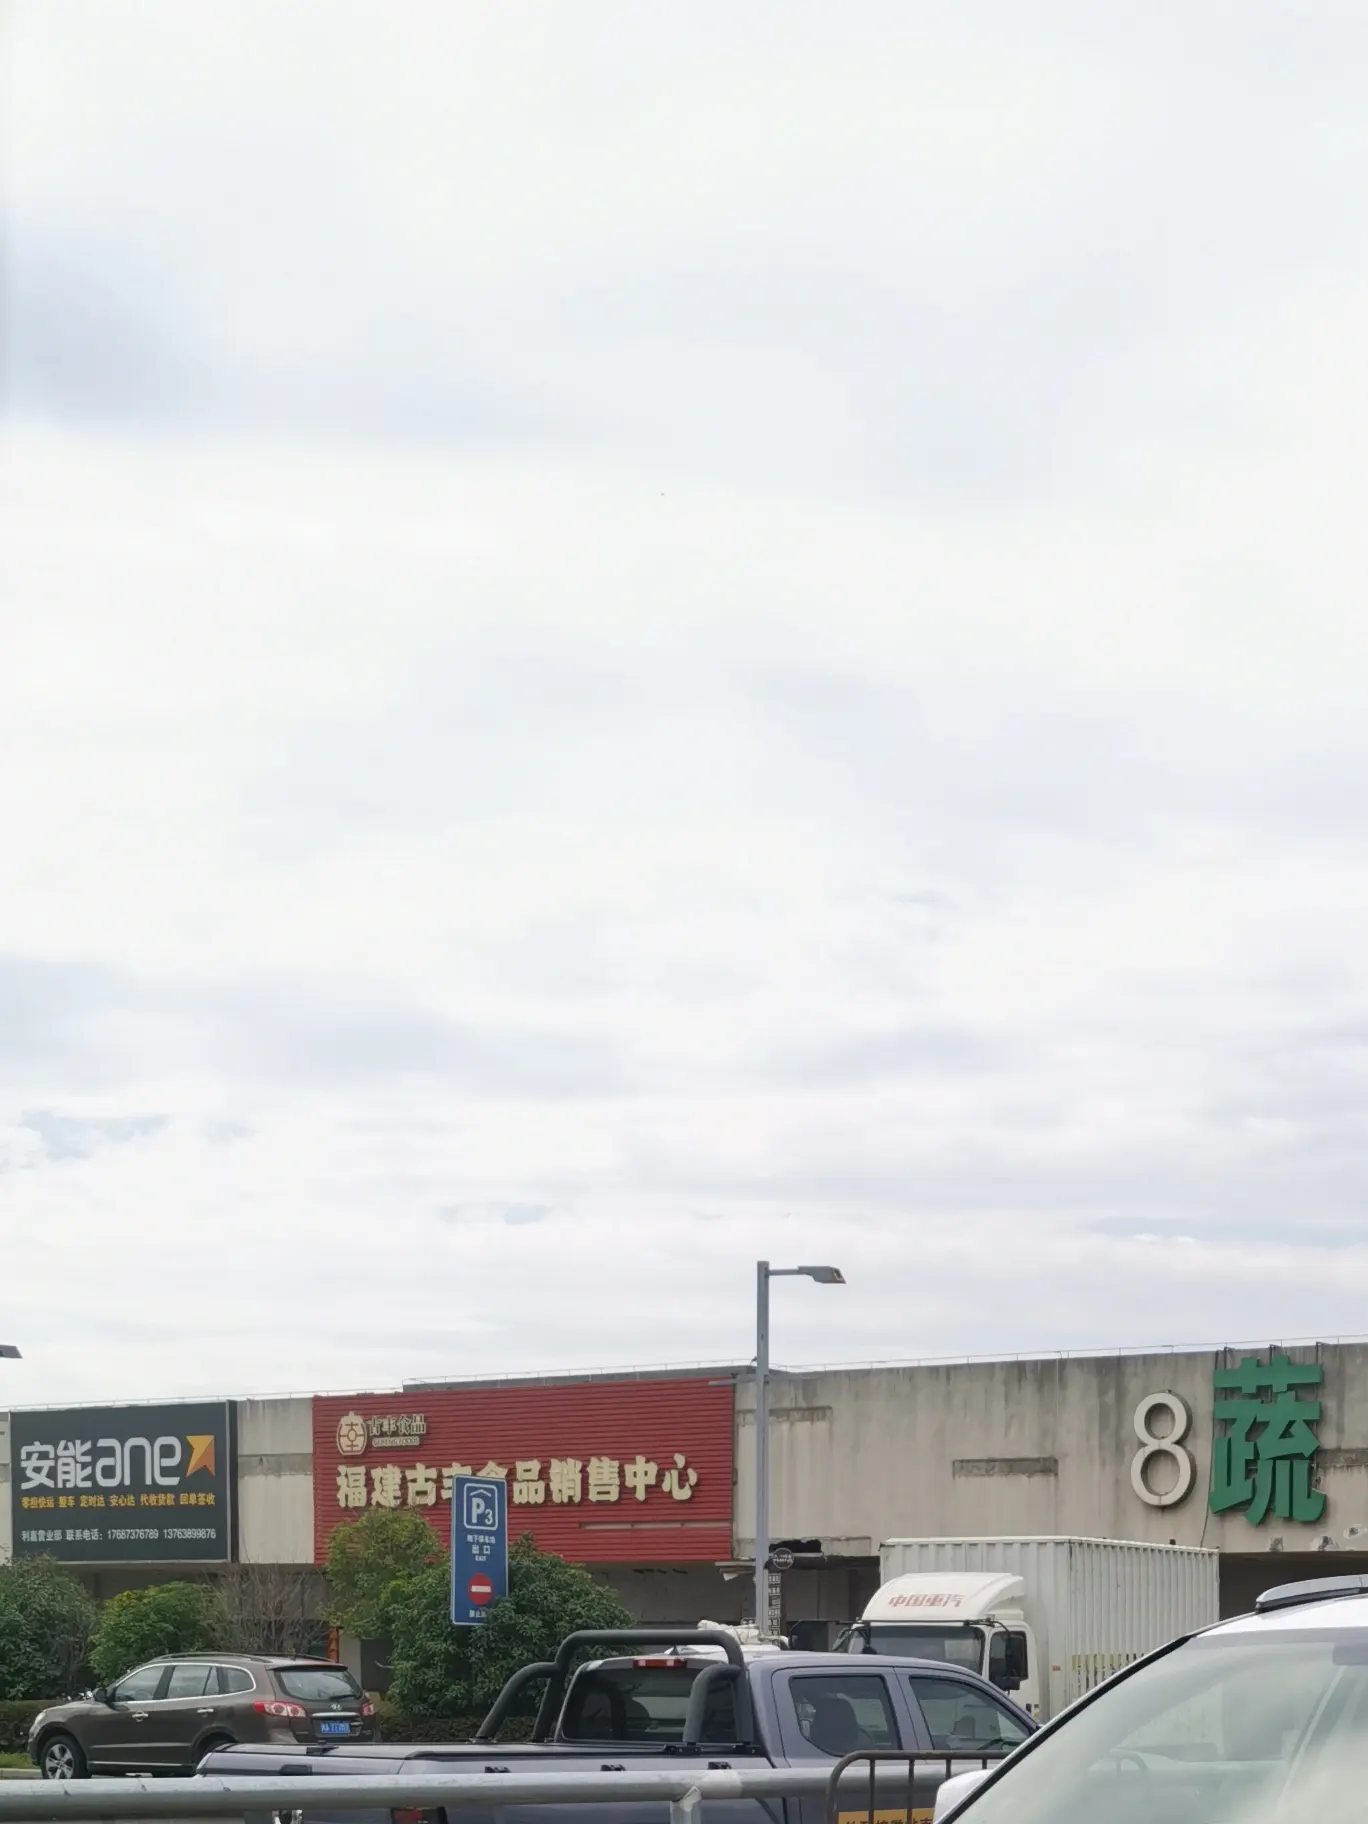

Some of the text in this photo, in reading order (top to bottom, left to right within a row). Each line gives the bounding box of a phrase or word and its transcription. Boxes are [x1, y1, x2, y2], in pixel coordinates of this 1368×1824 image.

[1131, 1390, 1196, 1507] 8
[888, 1594, 966, 1608] 中国重汽
